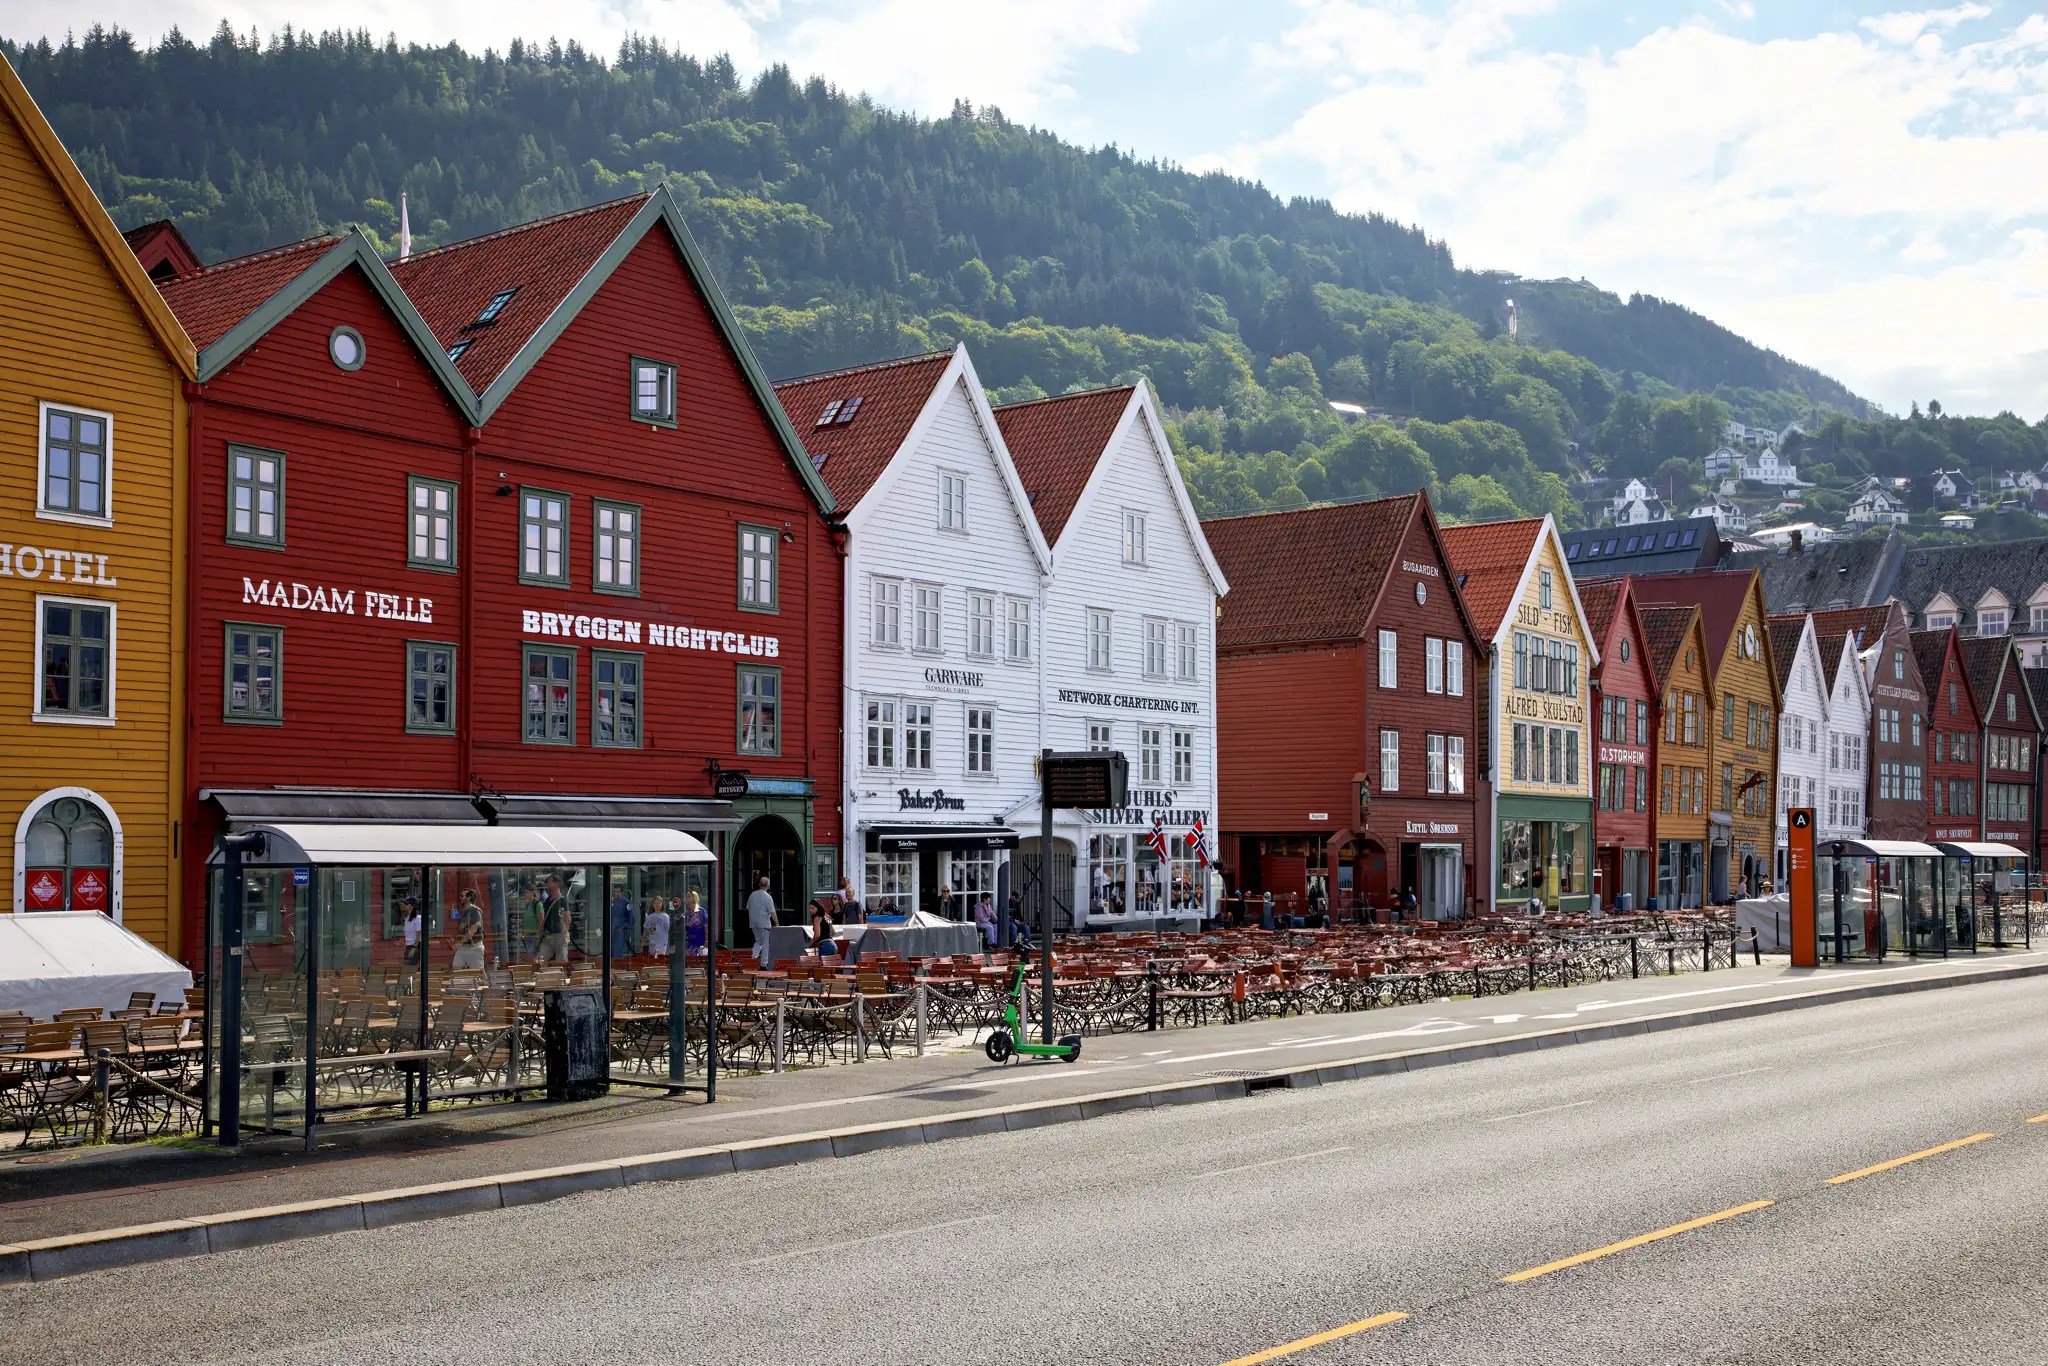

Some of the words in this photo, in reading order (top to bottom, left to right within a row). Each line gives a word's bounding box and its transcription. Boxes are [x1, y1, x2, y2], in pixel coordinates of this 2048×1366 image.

[0, 544, 116, 586] HOTEL
[1403, 561, 1439, 577] BUGAARDEN
[243, 577, 355, 615] MADAM
[365, 591, 433, 624] FELLE
[1519, 604, 1539, 626] SILD
[1554, 613, 1573, 635] FISK
[522, 610, 641, 643] BRYGGEN
[649, 624, 779, 658] NIGHTCLUB
[925, 668, 984, 687] GARWARE
[1059, 690, 1112, 706] NETWORK
[1114, 695, 1179, 712] CHARTERING
[1181, 701, 1200, 714] INT.
[1506, 696, 1538, 718] ALFRED
[1544, 701, 1583, 723] SKULSTAD
[1609, 749, 1645, 764] STORHEIM
[1093, 809, 1145, 825] SILVER
[1151, 810, 1209, 825] GALLERY
[1796, 814, 1806, 826] A
